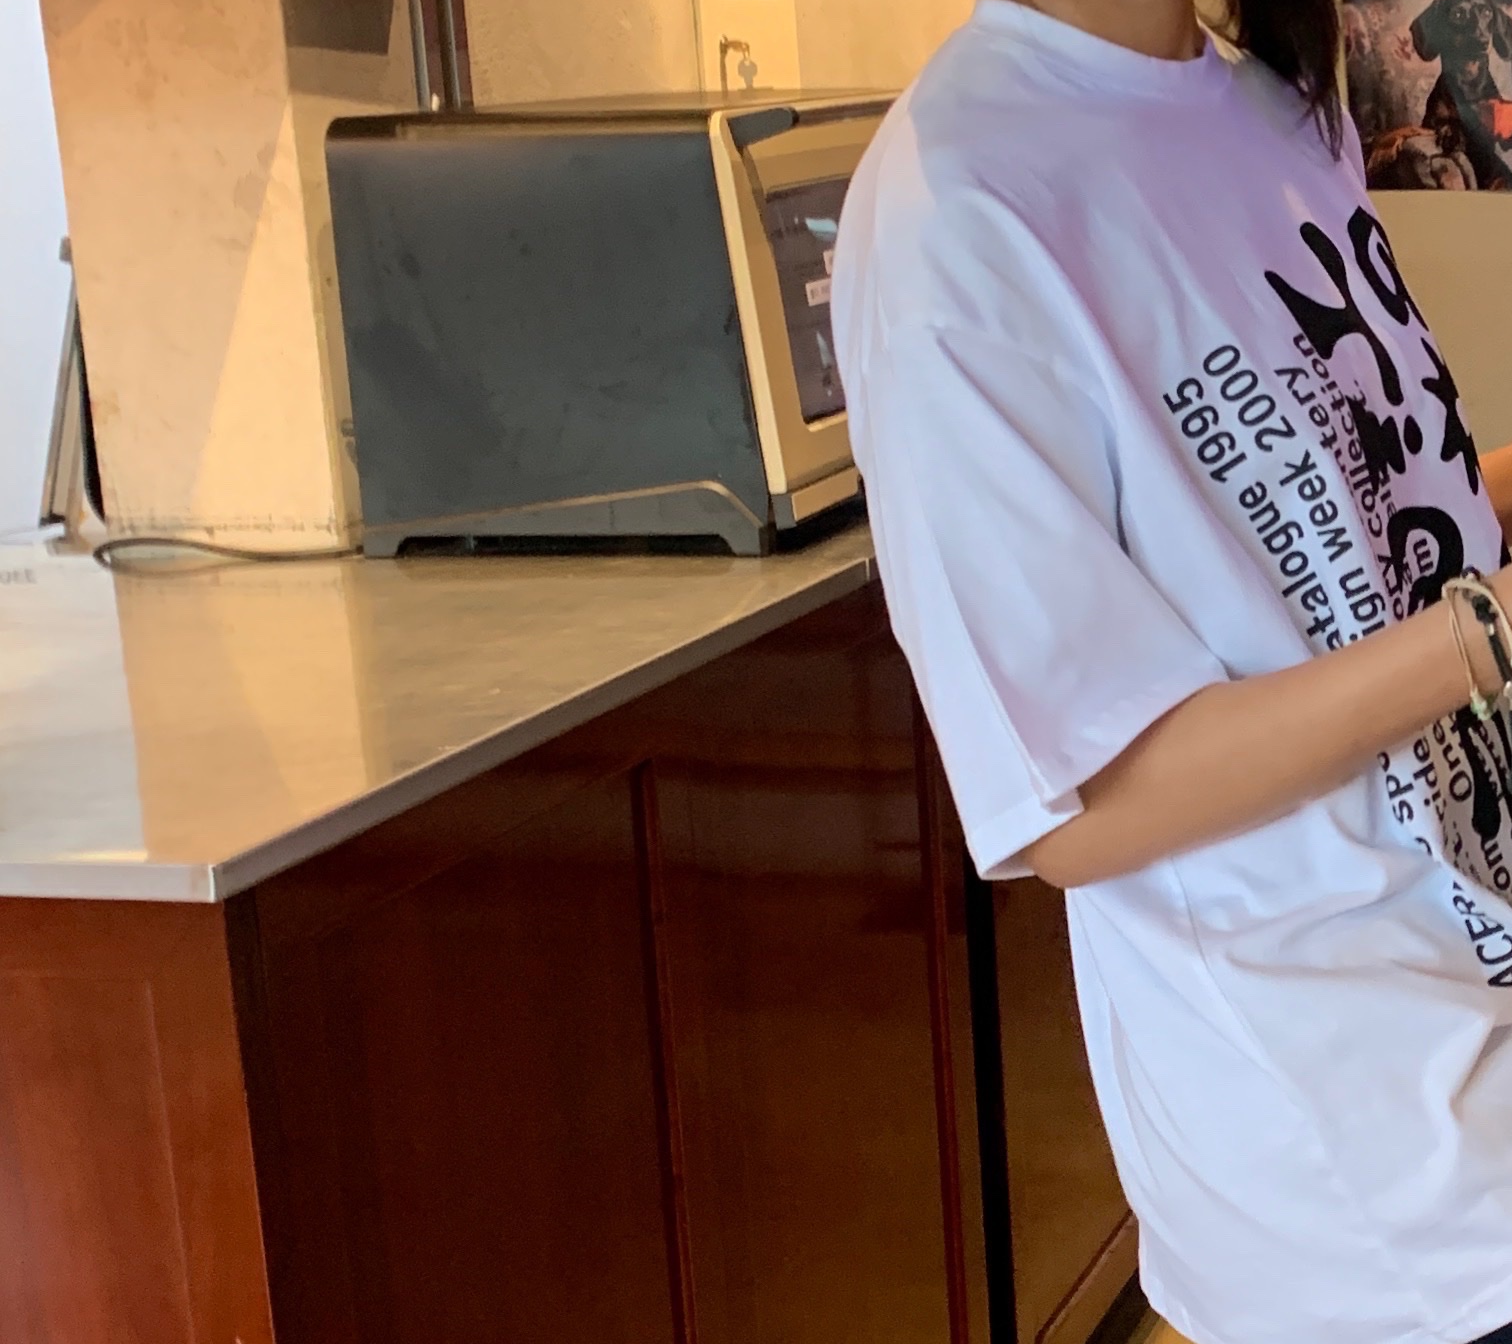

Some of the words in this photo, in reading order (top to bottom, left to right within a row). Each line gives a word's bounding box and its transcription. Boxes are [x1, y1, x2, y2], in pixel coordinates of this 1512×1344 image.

[1162, 377, 1248, 484] 1995
[1202, 344, 1297, 453] 2000
[1292, 333, 1384, 539] collection
[1278, 449, 1354, 563] week
[1238, 480, 1345, 652] atalogue
